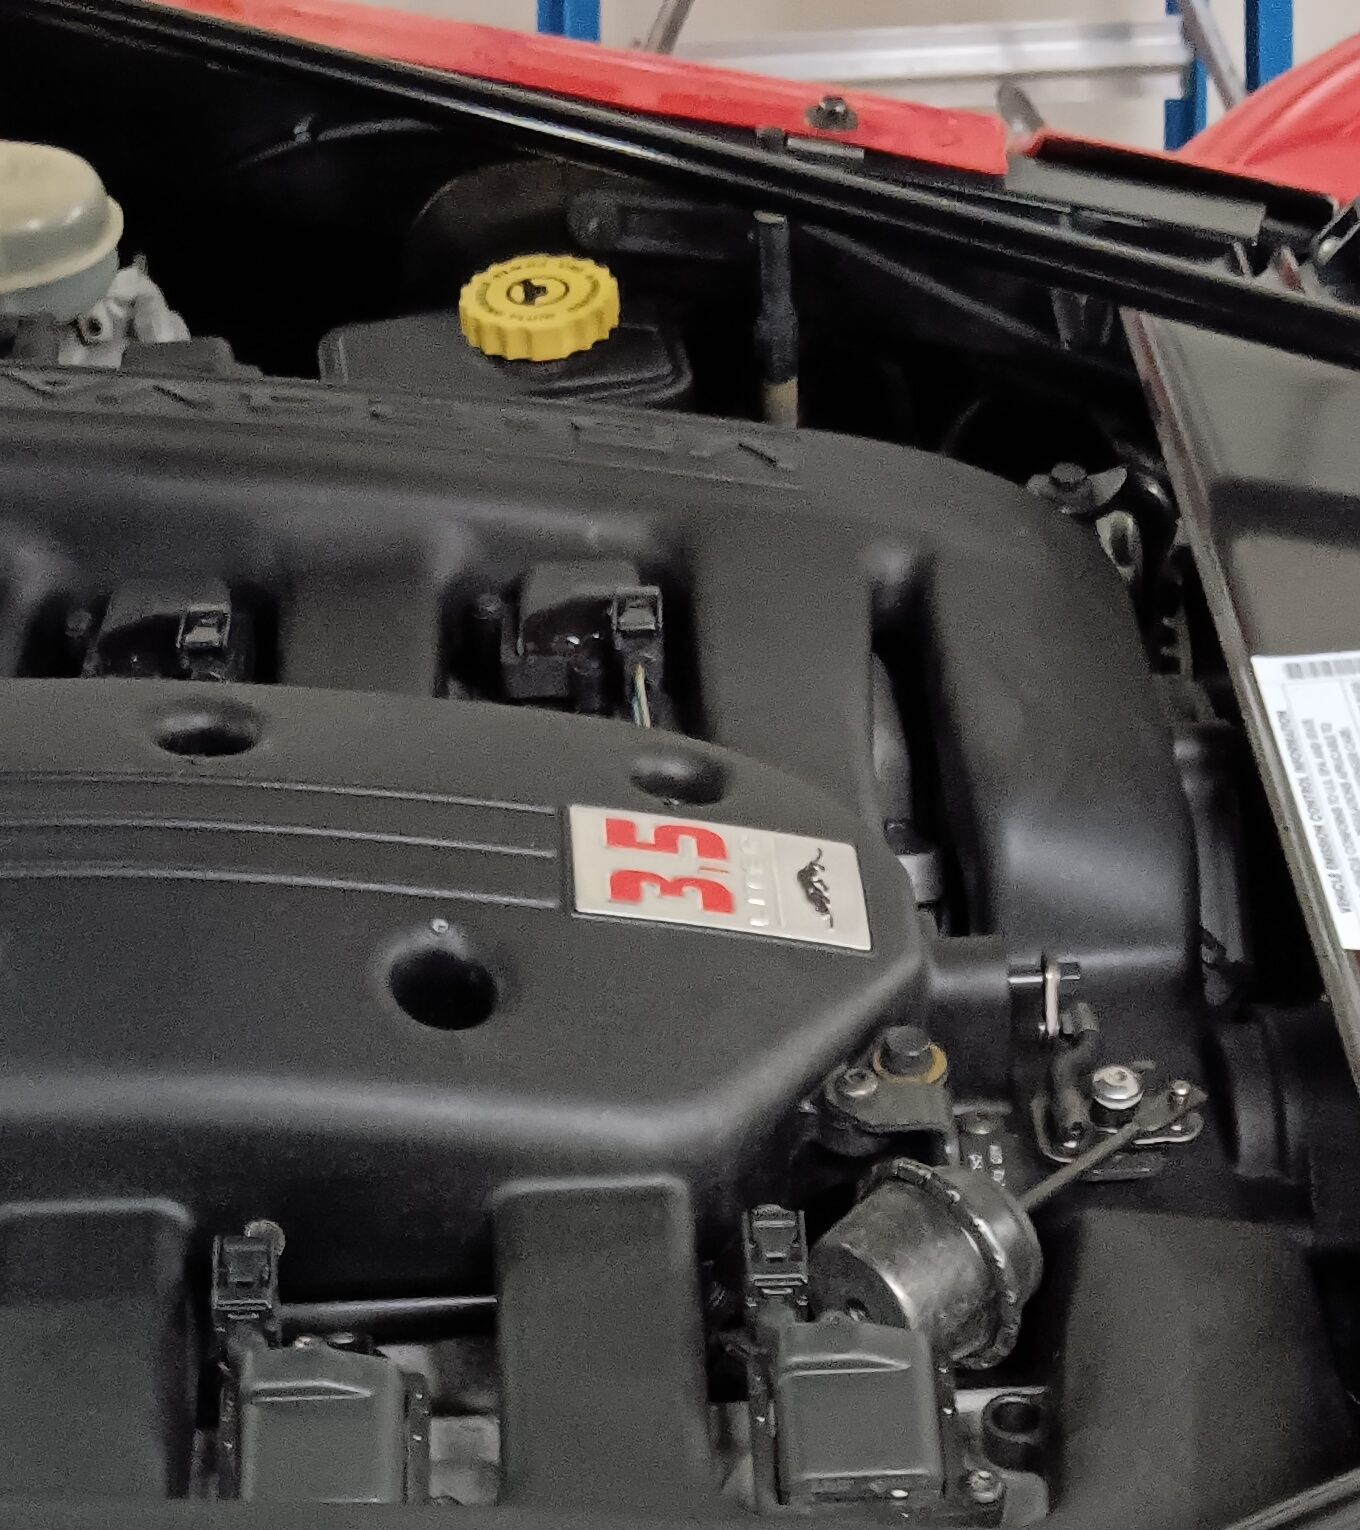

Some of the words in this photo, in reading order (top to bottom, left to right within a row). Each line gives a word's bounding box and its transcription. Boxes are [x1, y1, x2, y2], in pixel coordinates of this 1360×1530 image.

[1275, 709, 1307, 773] INFORMATION
[1296, 775, 1323, 822] CONTROL
[1311, 824, 1339, 870] EMISSION
[1327, 871, 1353, 913] VEHICLE
